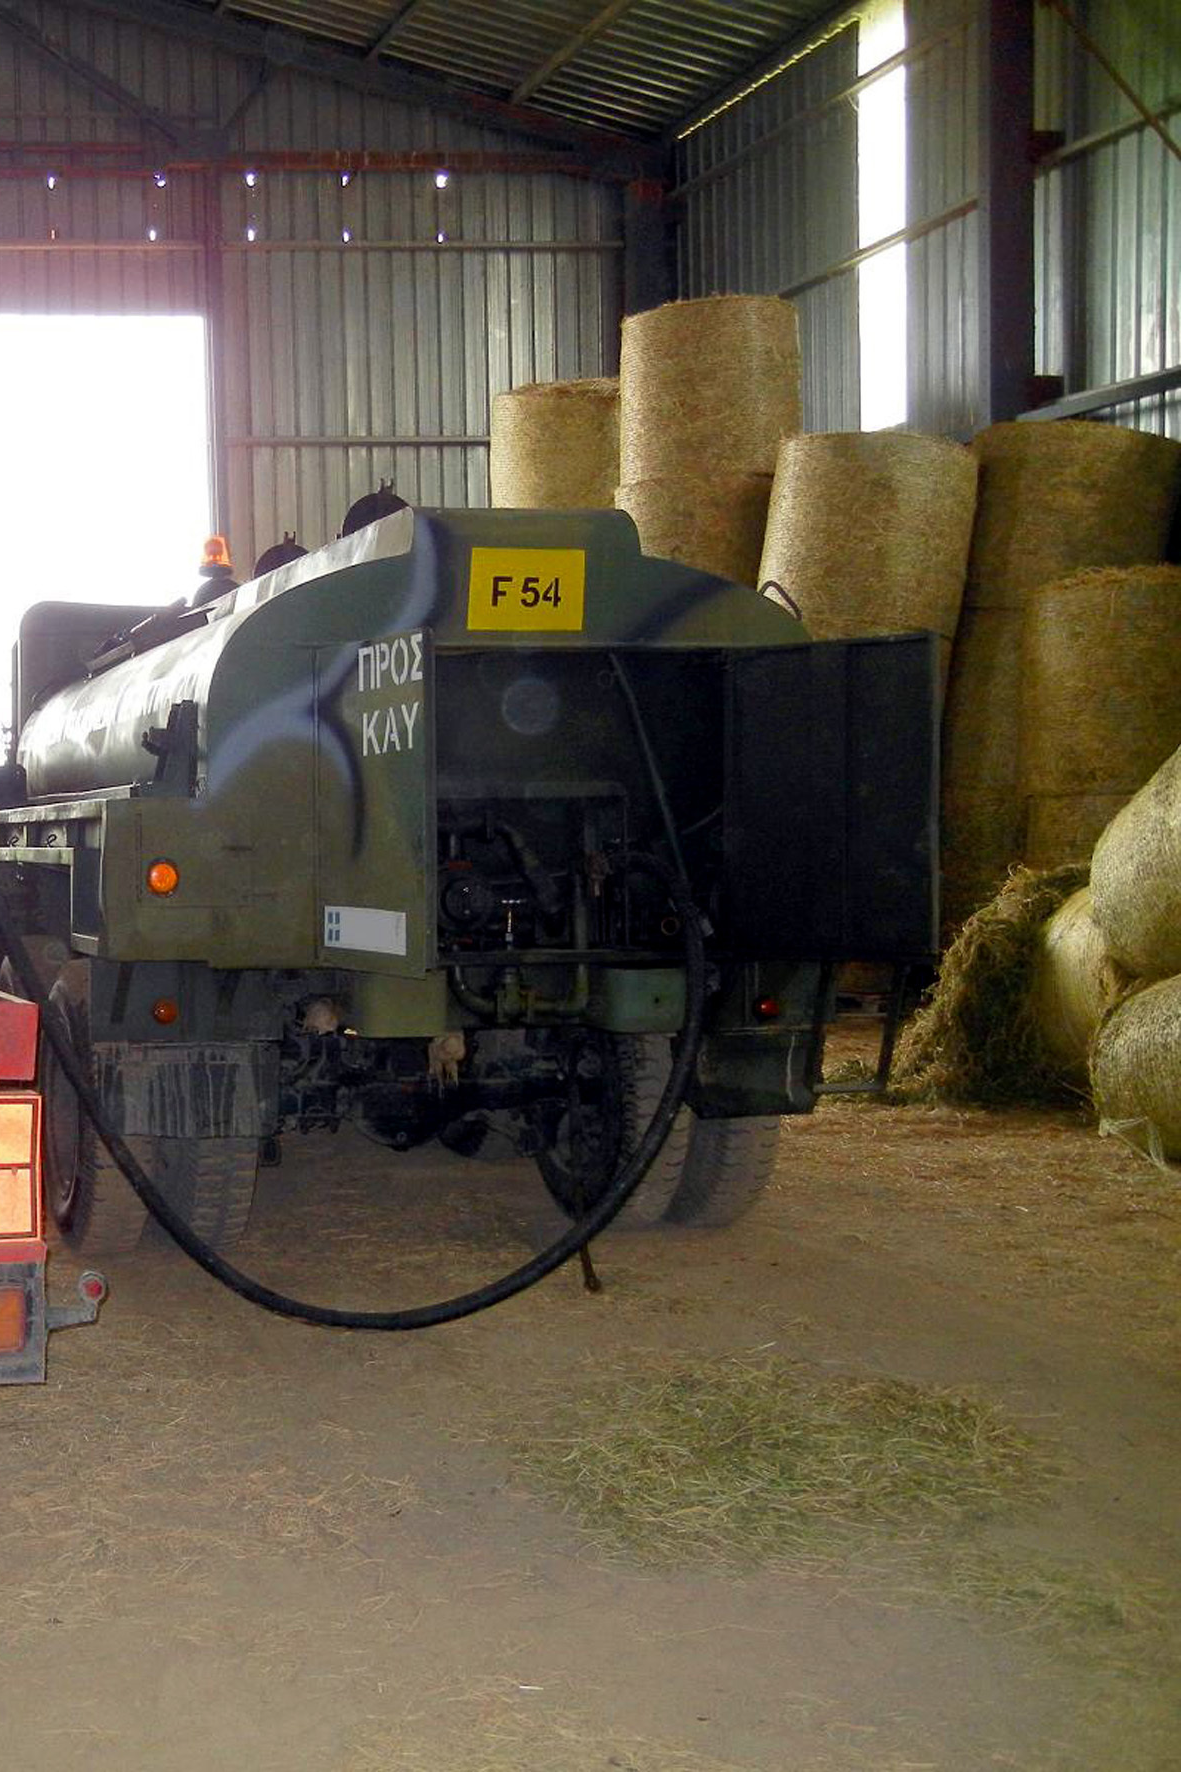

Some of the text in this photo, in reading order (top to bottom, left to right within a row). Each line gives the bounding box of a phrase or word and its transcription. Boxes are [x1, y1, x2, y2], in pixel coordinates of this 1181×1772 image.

[490, 575, 562, 608] F 54
[358, 632, 424, 692] ΠΡΟΣ
[362, 701, 420, 757] ΚΑΥ
